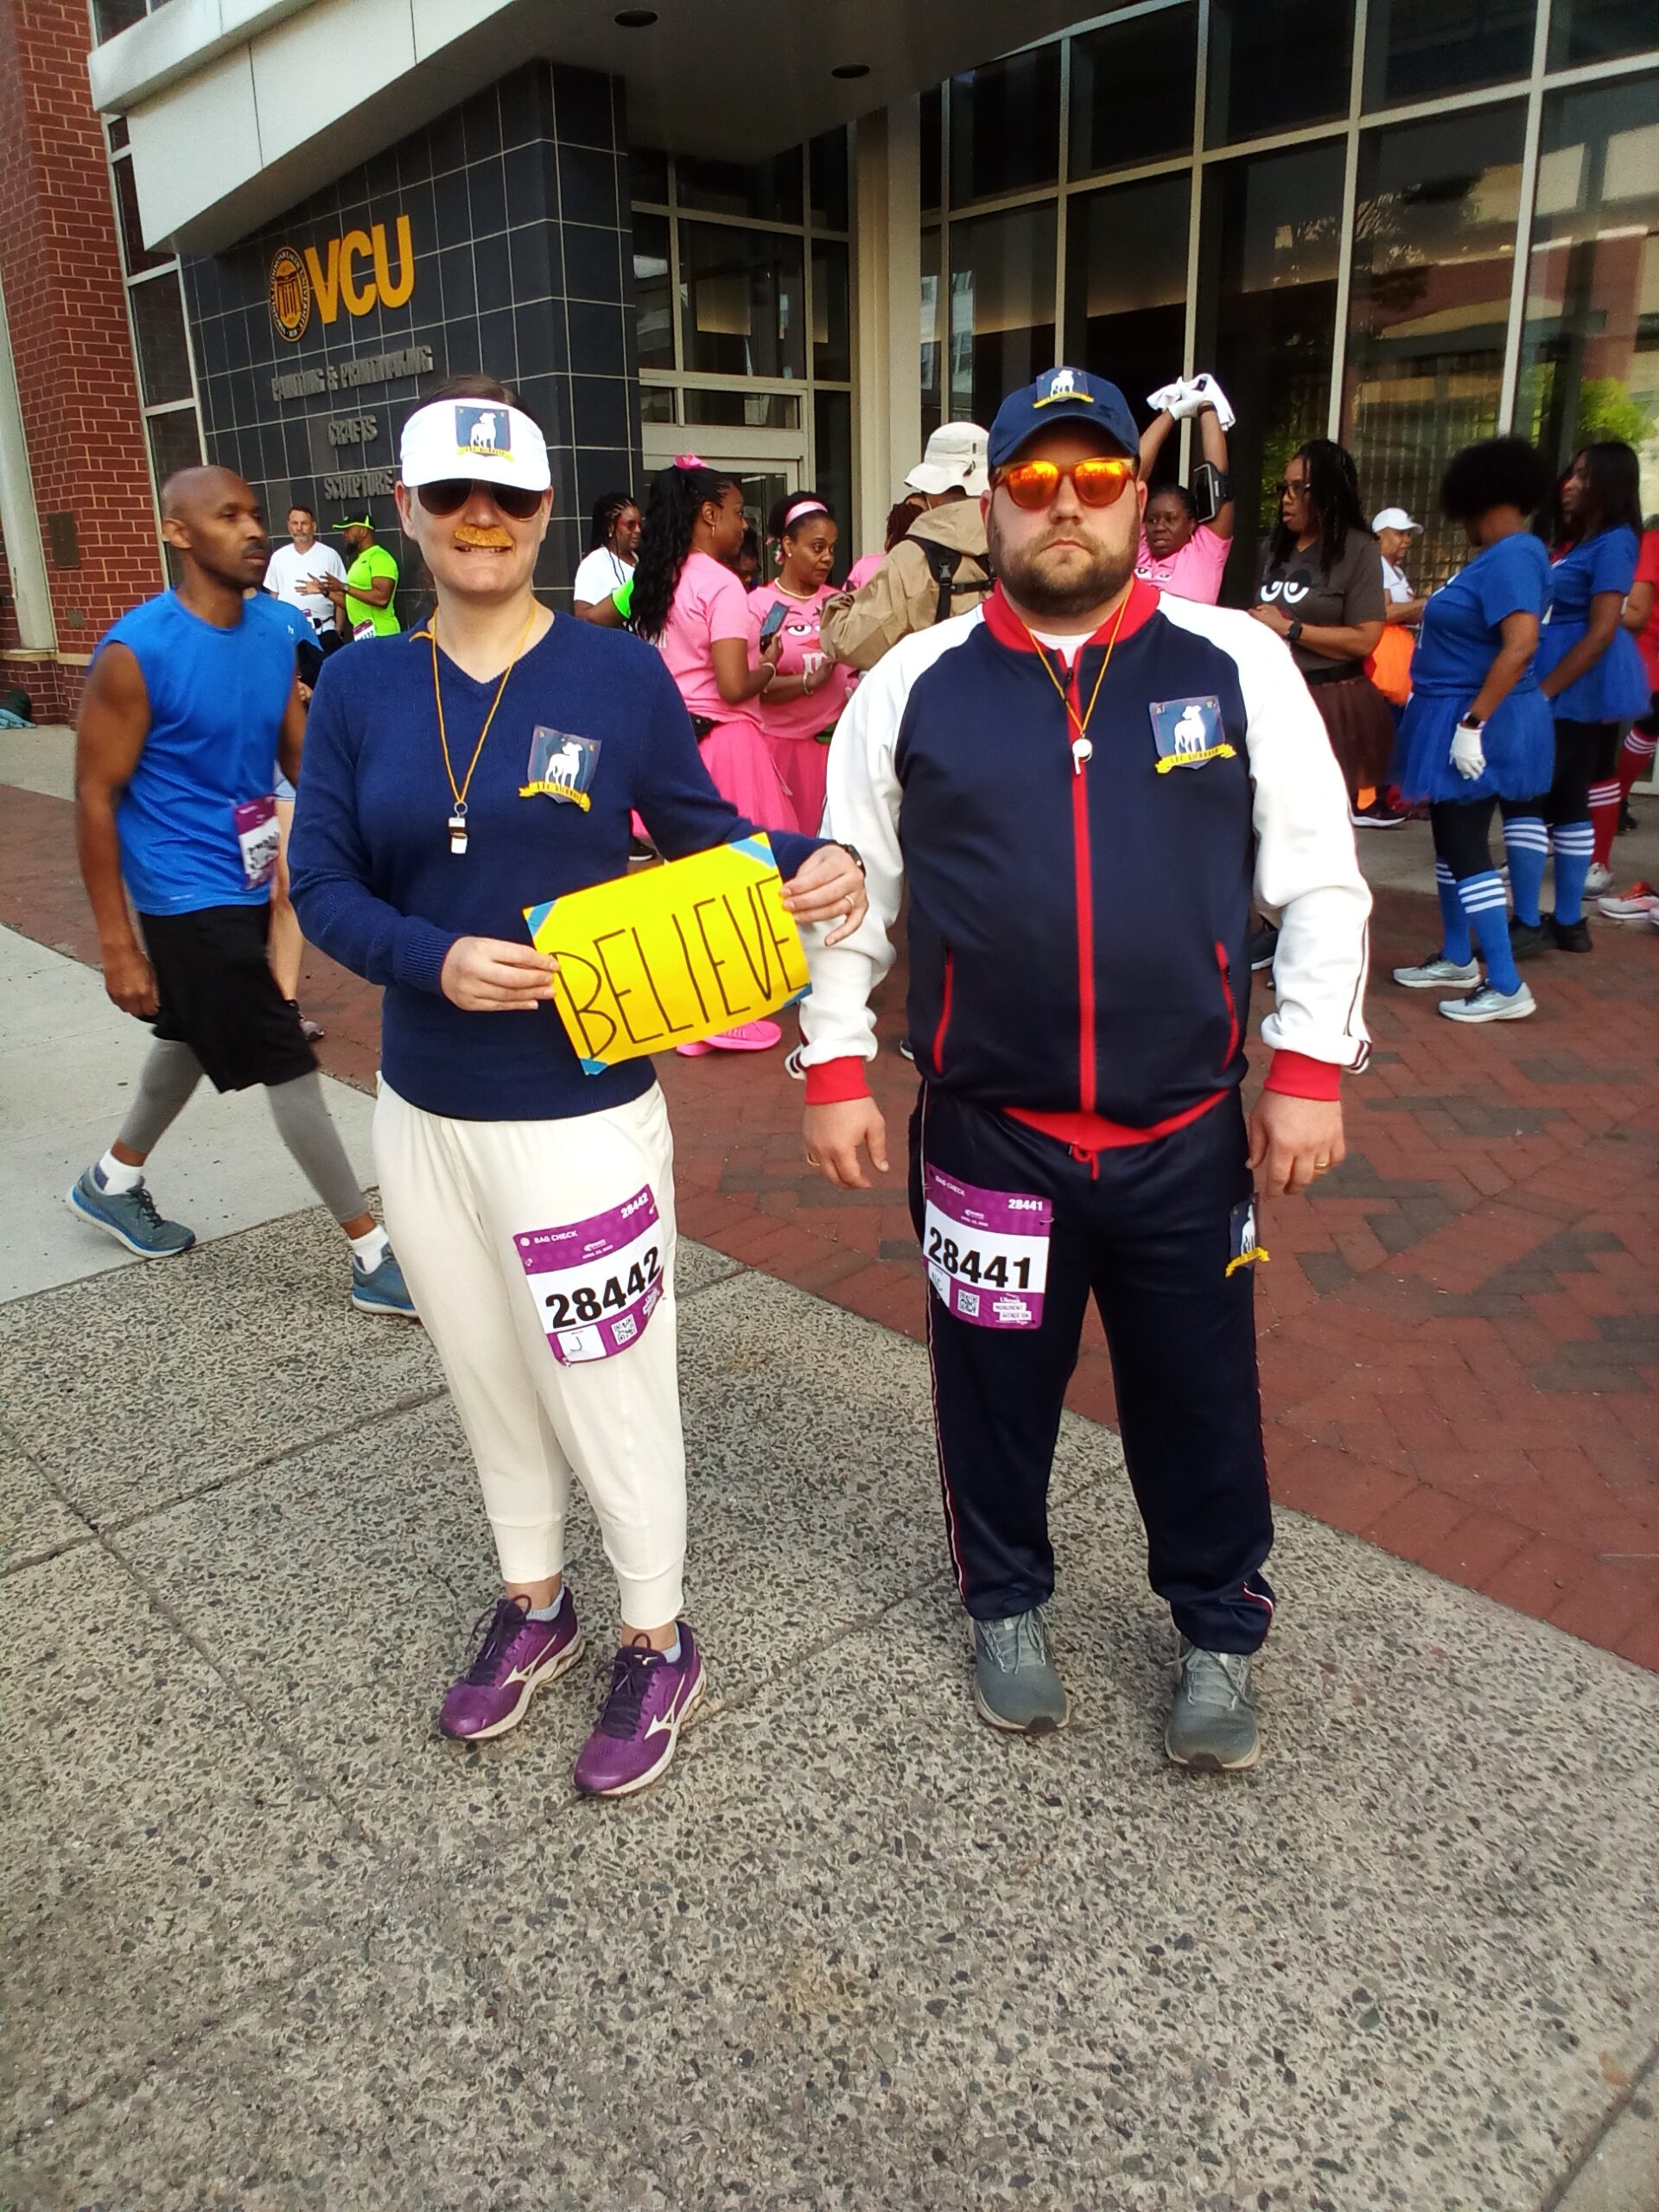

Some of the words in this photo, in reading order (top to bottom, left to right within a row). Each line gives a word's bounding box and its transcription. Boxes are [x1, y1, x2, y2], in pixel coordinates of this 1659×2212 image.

[304, 214, 415, 325] VCU
[328, 415, 378, 446] CRAFTS
[324, 469, 395, 500] SCULPTURE
[548, 874, 810, 1058] BELIEVE
[620, 1192, 649, 1219] 28442
[1007, 1198, 1043, 1211] 28441
[533, 1236, 550, 1244] BAG
[550, 1230, 579, 1242] CHECK
[928, 1226, 1031, 1289] 28441
[545, 1246, 661, 1329] 28442
